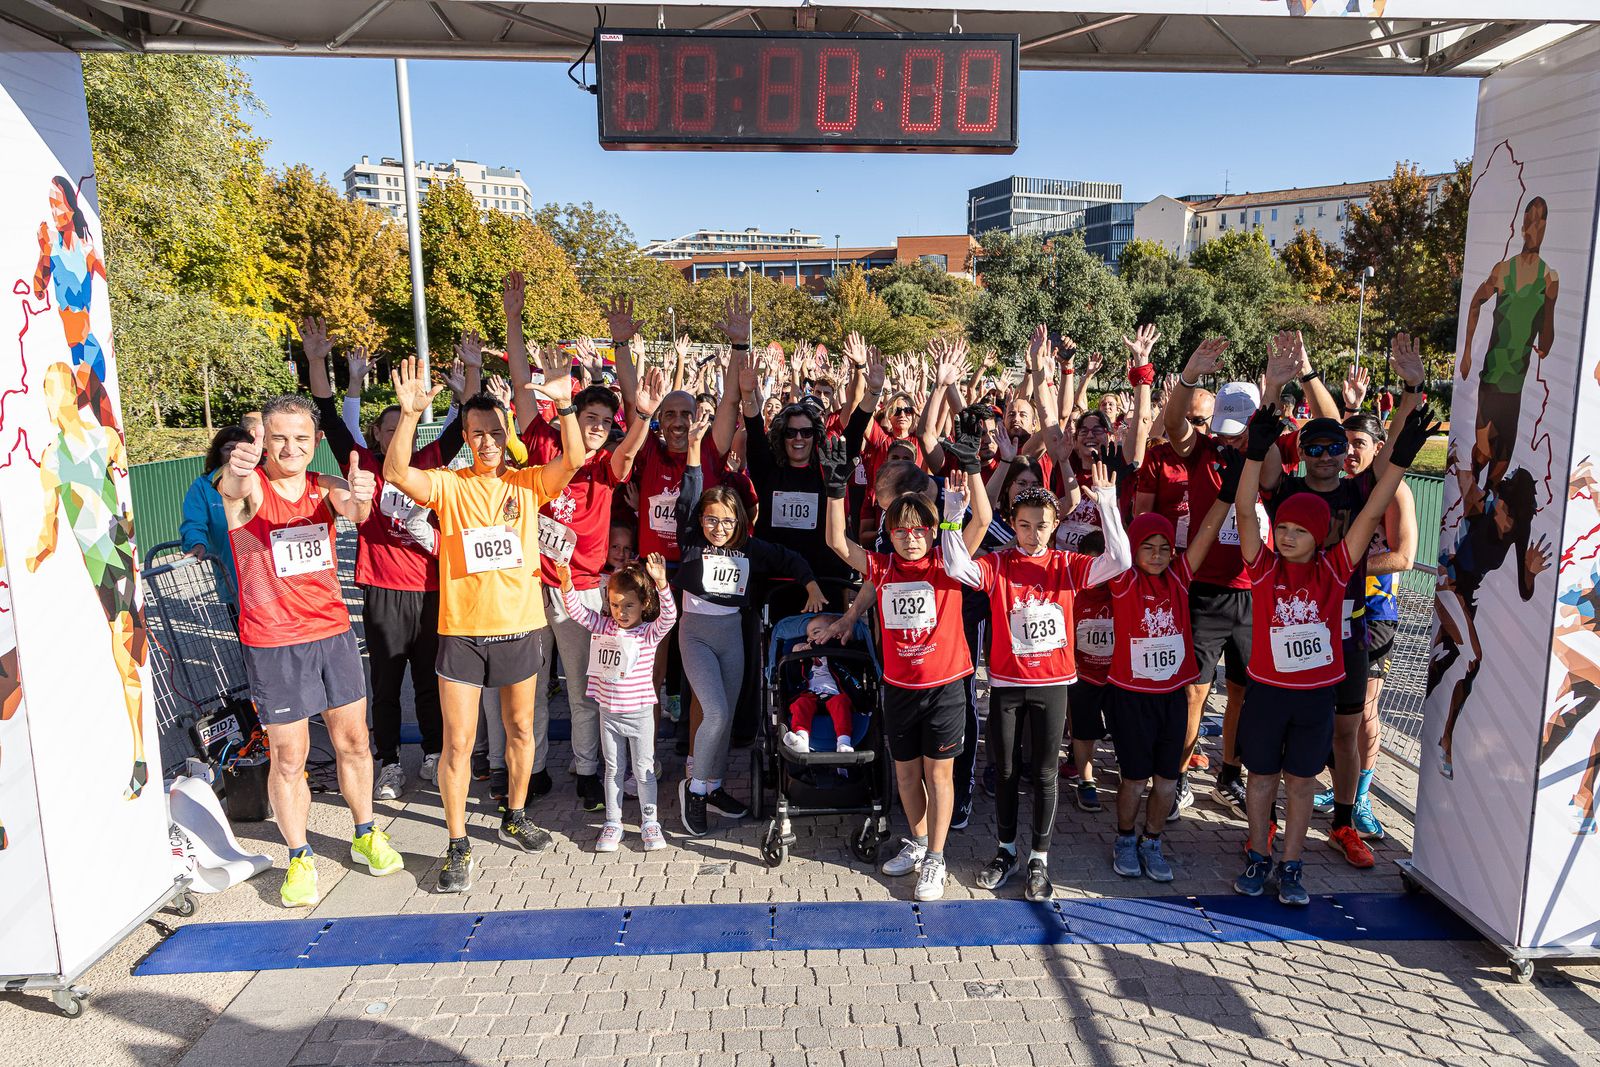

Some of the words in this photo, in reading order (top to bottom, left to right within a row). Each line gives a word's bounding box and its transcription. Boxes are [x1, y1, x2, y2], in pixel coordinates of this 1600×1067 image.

[392, 493, 413, 508] 112
[654, 505, 677, 520] 044
[782, 503, 810, 518] 1103
[286, 539, 322, 561] 1138
[474, 538, 512, 559] 0629
[713, 566, 741, 583] 1075
[892, 596, 926, 616] 1232
[1022, 618, 1056, 640] 1233
[1086, 630, 1114, 645] 1041
[598, 648, 621, 667] 1076
[1284, 637, 1322, 659] 1066
[1143, 649, 1176, 668] 1165
[203, 720, 227, 739] RFID
